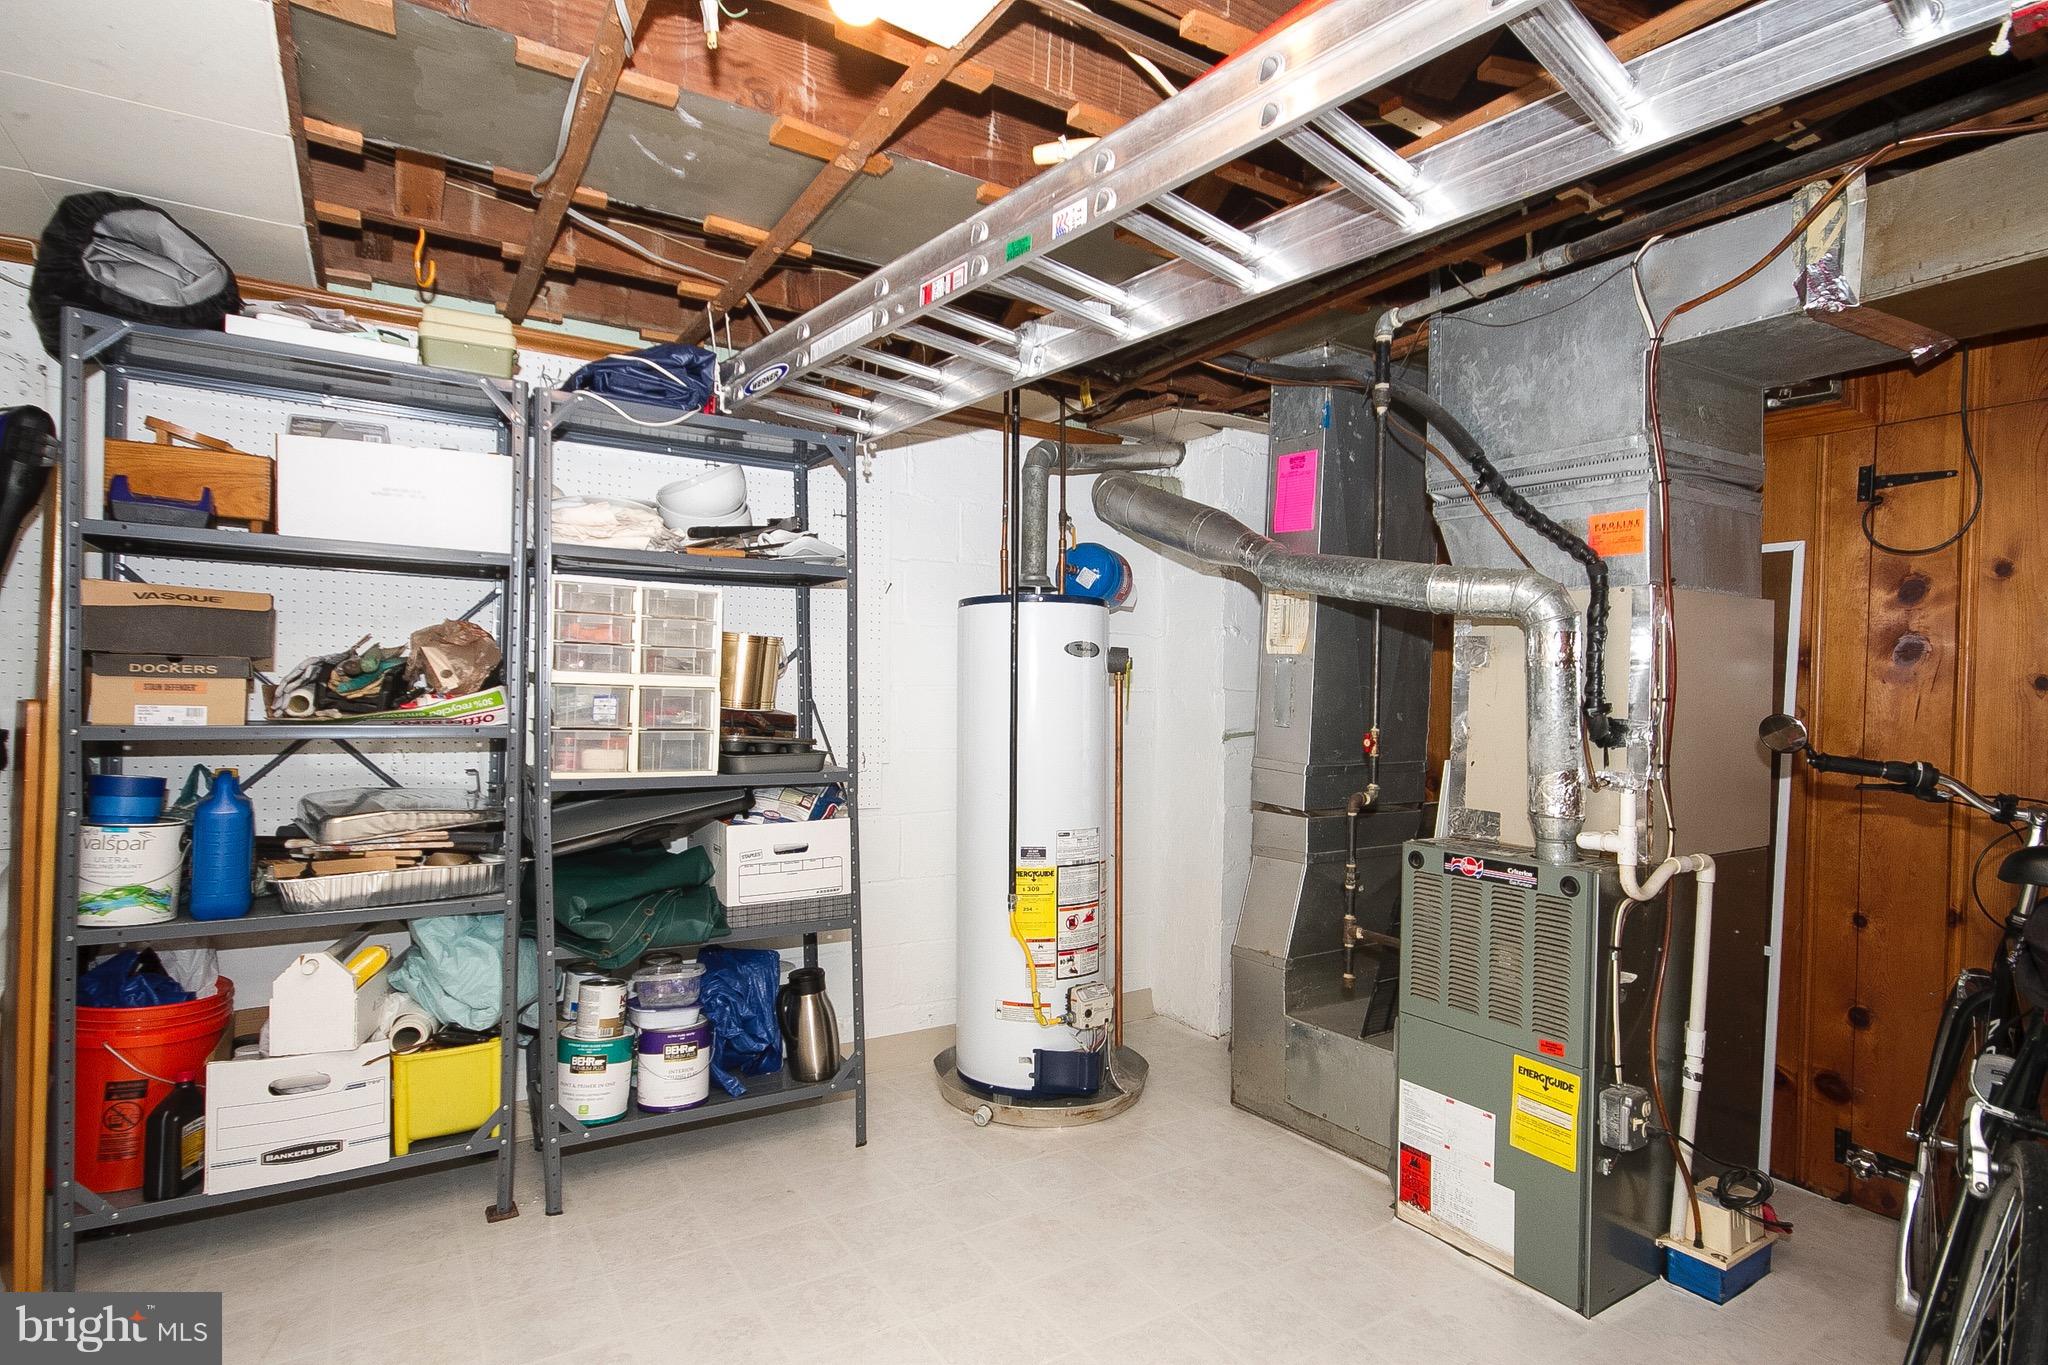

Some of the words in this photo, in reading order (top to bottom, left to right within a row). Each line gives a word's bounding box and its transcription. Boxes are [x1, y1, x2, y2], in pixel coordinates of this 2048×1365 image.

[752, 370, 779, 390] WERNER
[132, 591, 226, 604] VASQUE
[128, 663, 218, 675] DOCKERS
[164, 683, 196, 691] DEFENDER
[473, 697, 494, 708] 30%
[428, 701, 473, 717] recycled
[446, 713, 495, 726] Office
[83, 835, 153, 854] valspar
[1015, 870, 1055, 878] NERGYGUIDE
[1507, 867, 1533, 877] Criterion
[665, 1044, 689, 1055] BEHR
[571, 1056, 596, 1066] BEHR
[1518, 1065, 1575, 1093] ENERGYGUIDE
[265, 1148, 314, 1162] BANKERS
[316, 1144, 339, 1154] BOX
